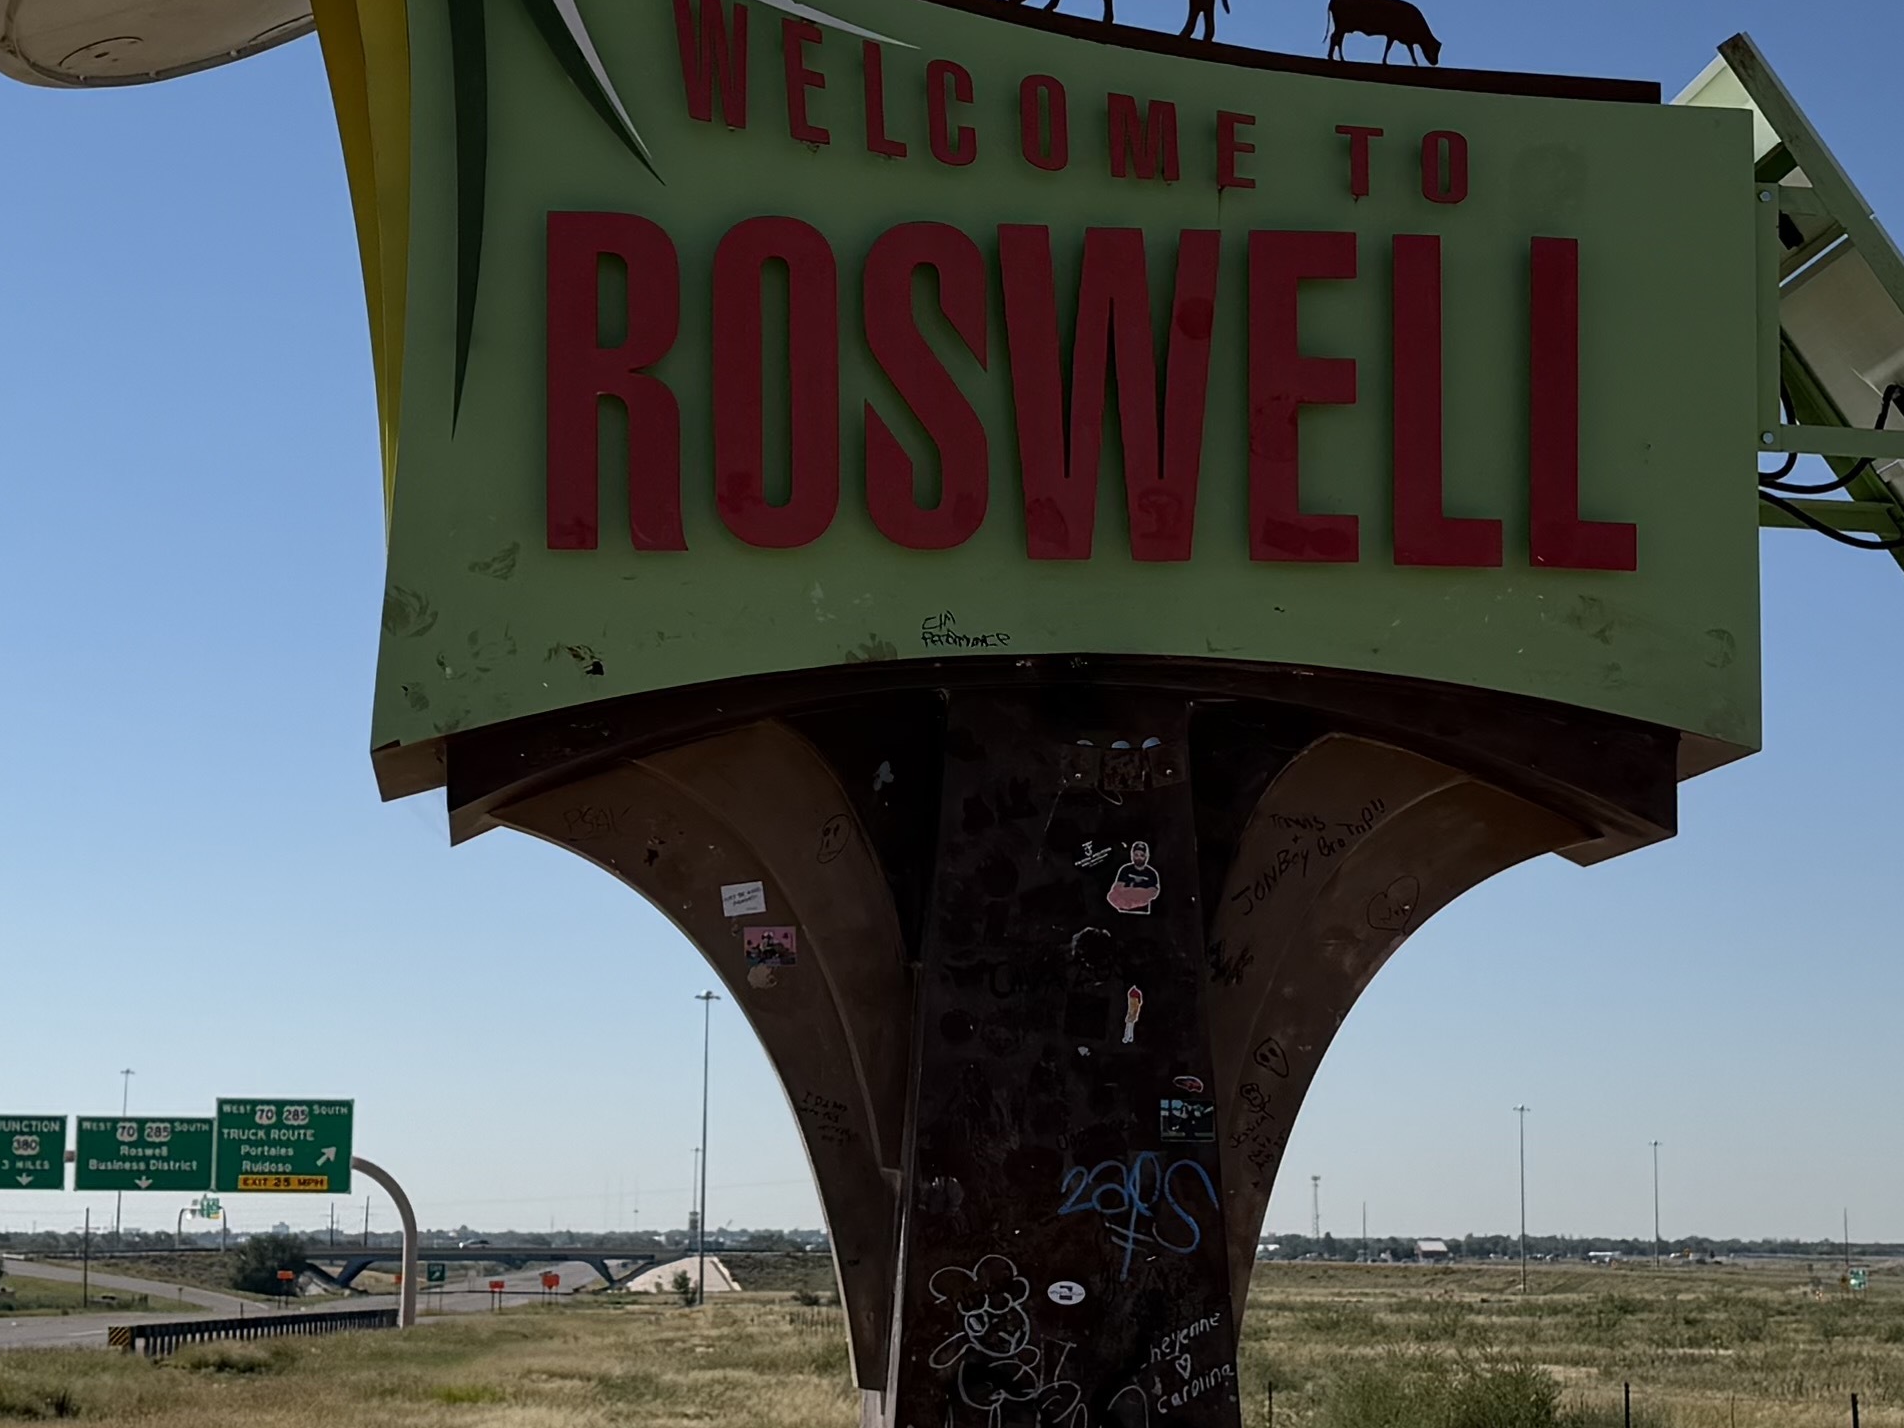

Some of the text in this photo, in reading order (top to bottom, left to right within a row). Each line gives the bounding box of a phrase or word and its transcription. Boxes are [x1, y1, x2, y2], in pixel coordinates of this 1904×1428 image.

[1334, 123, 1470, 205] TO
[545, 211, 1638, 571] ROSWELL
[222, 1104, 348, 1122] WEST 70 285 SOUTH
[82, 1121, 210, 1138] WEST 70 285 SOUTH
[221, 1128, 315, 1141] TRUCK ROUTE
[13, 1138, 39, 1151] 380
[119, 1145, 168, 1157] Roswell
[240, 1144, 294, 1157] Portales
[15, 1160, 50, 1170] MILES
[88, 1159, 198, 1171] Business District
[242, 1160, 292, 1173] Ruidoso
[242, 1176, 268, 1187] EXIT
